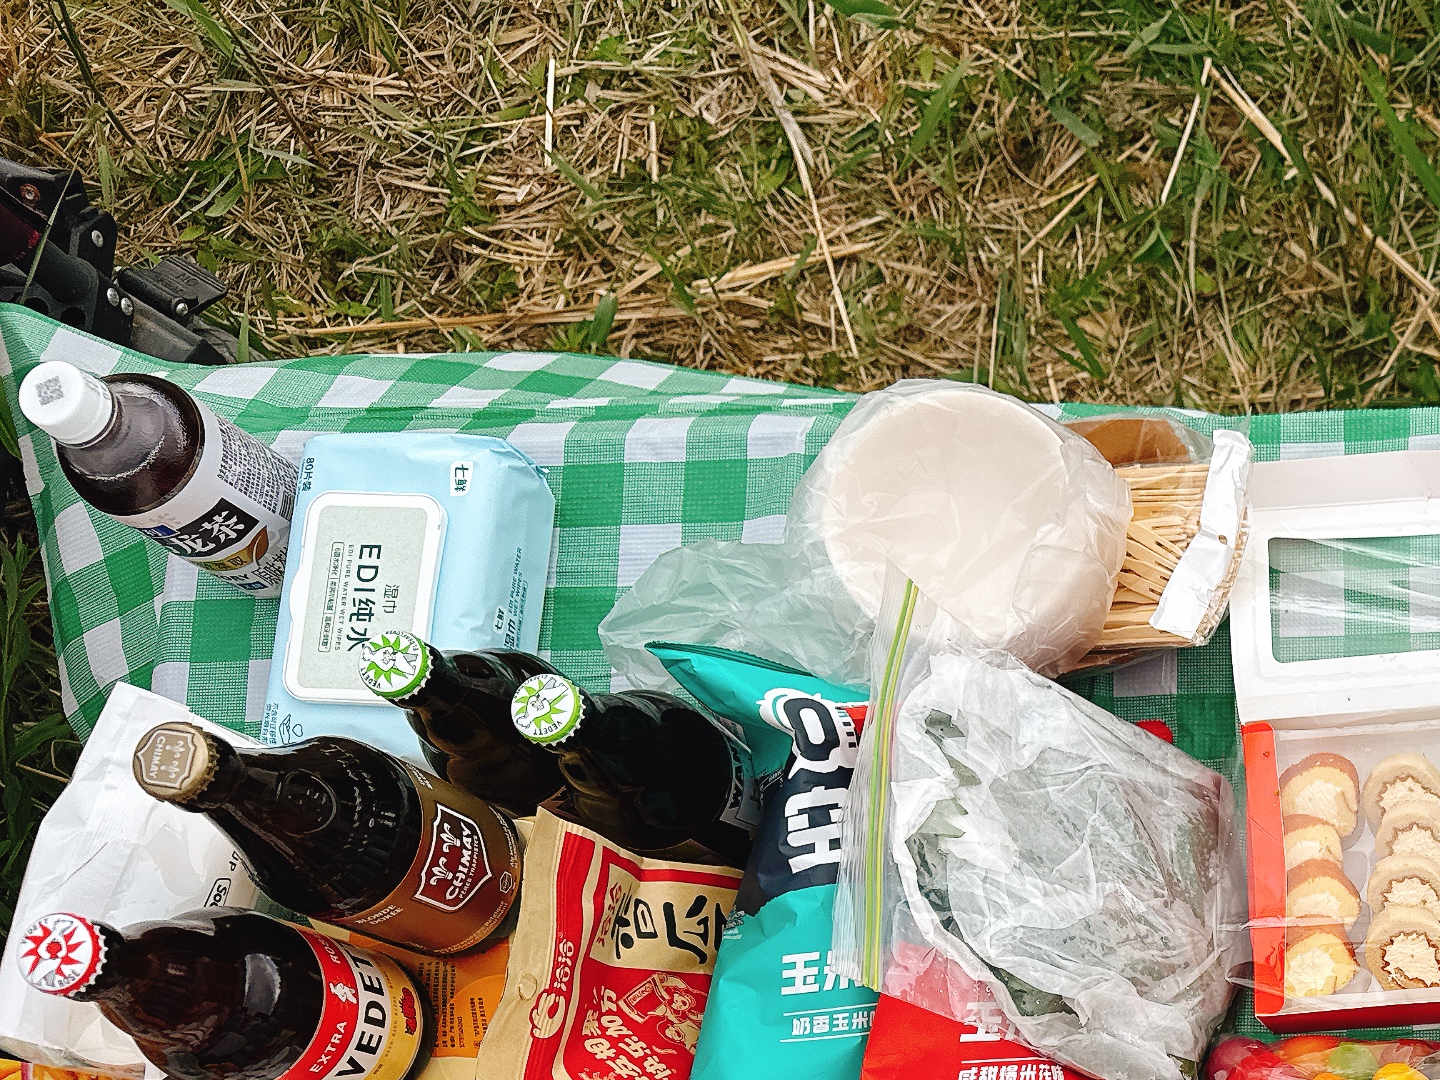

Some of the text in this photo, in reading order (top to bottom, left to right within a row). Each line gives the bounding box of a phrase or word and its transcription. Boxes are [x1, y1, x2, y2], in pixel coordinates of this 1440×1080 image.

[166, 510, 246, 555] 龙茶
[342, 582, 350, 603] WATER
[346, 544, 383, 652] EDI纯水
[384, 584, 400, 613] 湿巾
[361, 666, 382, 689] VEDETT
[532, 721, 563, 736] VEDETT
[149, 736, 166, 779] CHIMAY
[445, 821, 474, 901] CHIMAY
[333, 953, 387, 1078] VEDET
[308, 1021, 348, 1073] EXTRA
